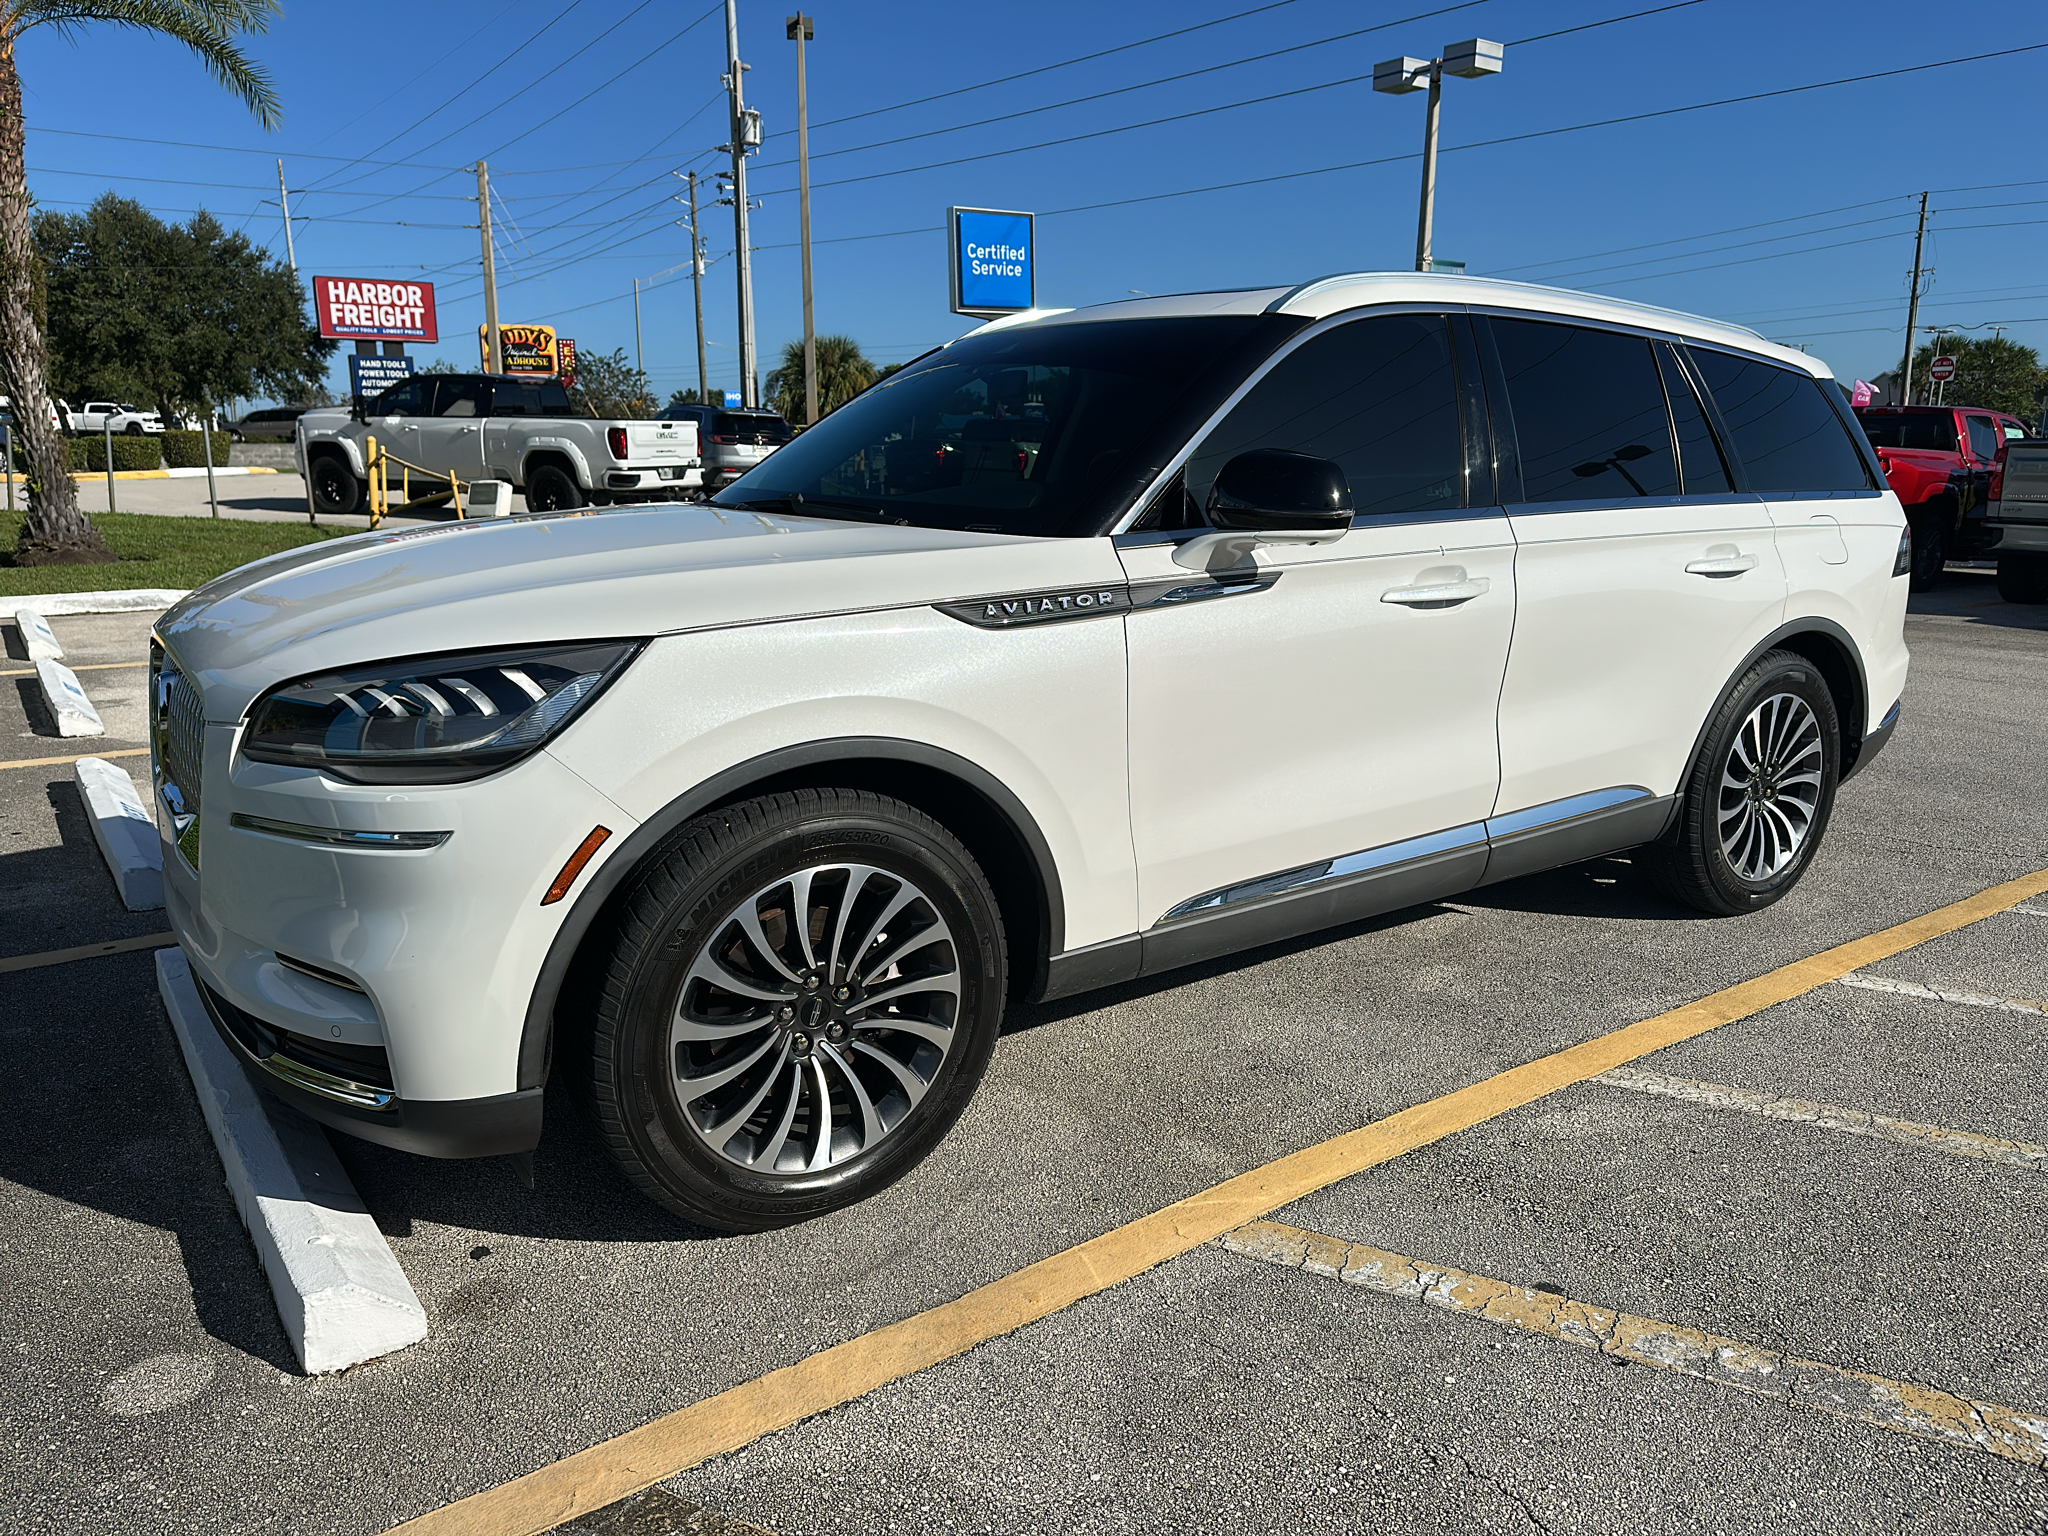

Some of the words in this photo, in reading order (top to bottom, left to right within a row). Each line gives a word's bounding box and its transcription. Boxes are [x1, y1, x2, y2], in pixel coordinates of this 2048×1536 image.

[967, 243, 1025, 260] Certified
[972, 260, 1022, 276] Service
[328, 281, 423, 306] HARBOR
[330, 303, 424, 328] FREIGHT
[502, 328, 550, 351] ODY'S
[360, 360, 381, 368] HAND
[382, 360, 406, 369] TOOLS
[504, 356, 549, 366] ADHOUSE
[358, 369, 385, 378] POWER
[386, 370, 410, 378] TOOLS
[361, 379, 399, 388] AUTOMOT
[725, 392, 742, 401] IHO
[983, 592, 1114, 619] AVIATOR
[809, 831, 890, 848] 255/55R20
